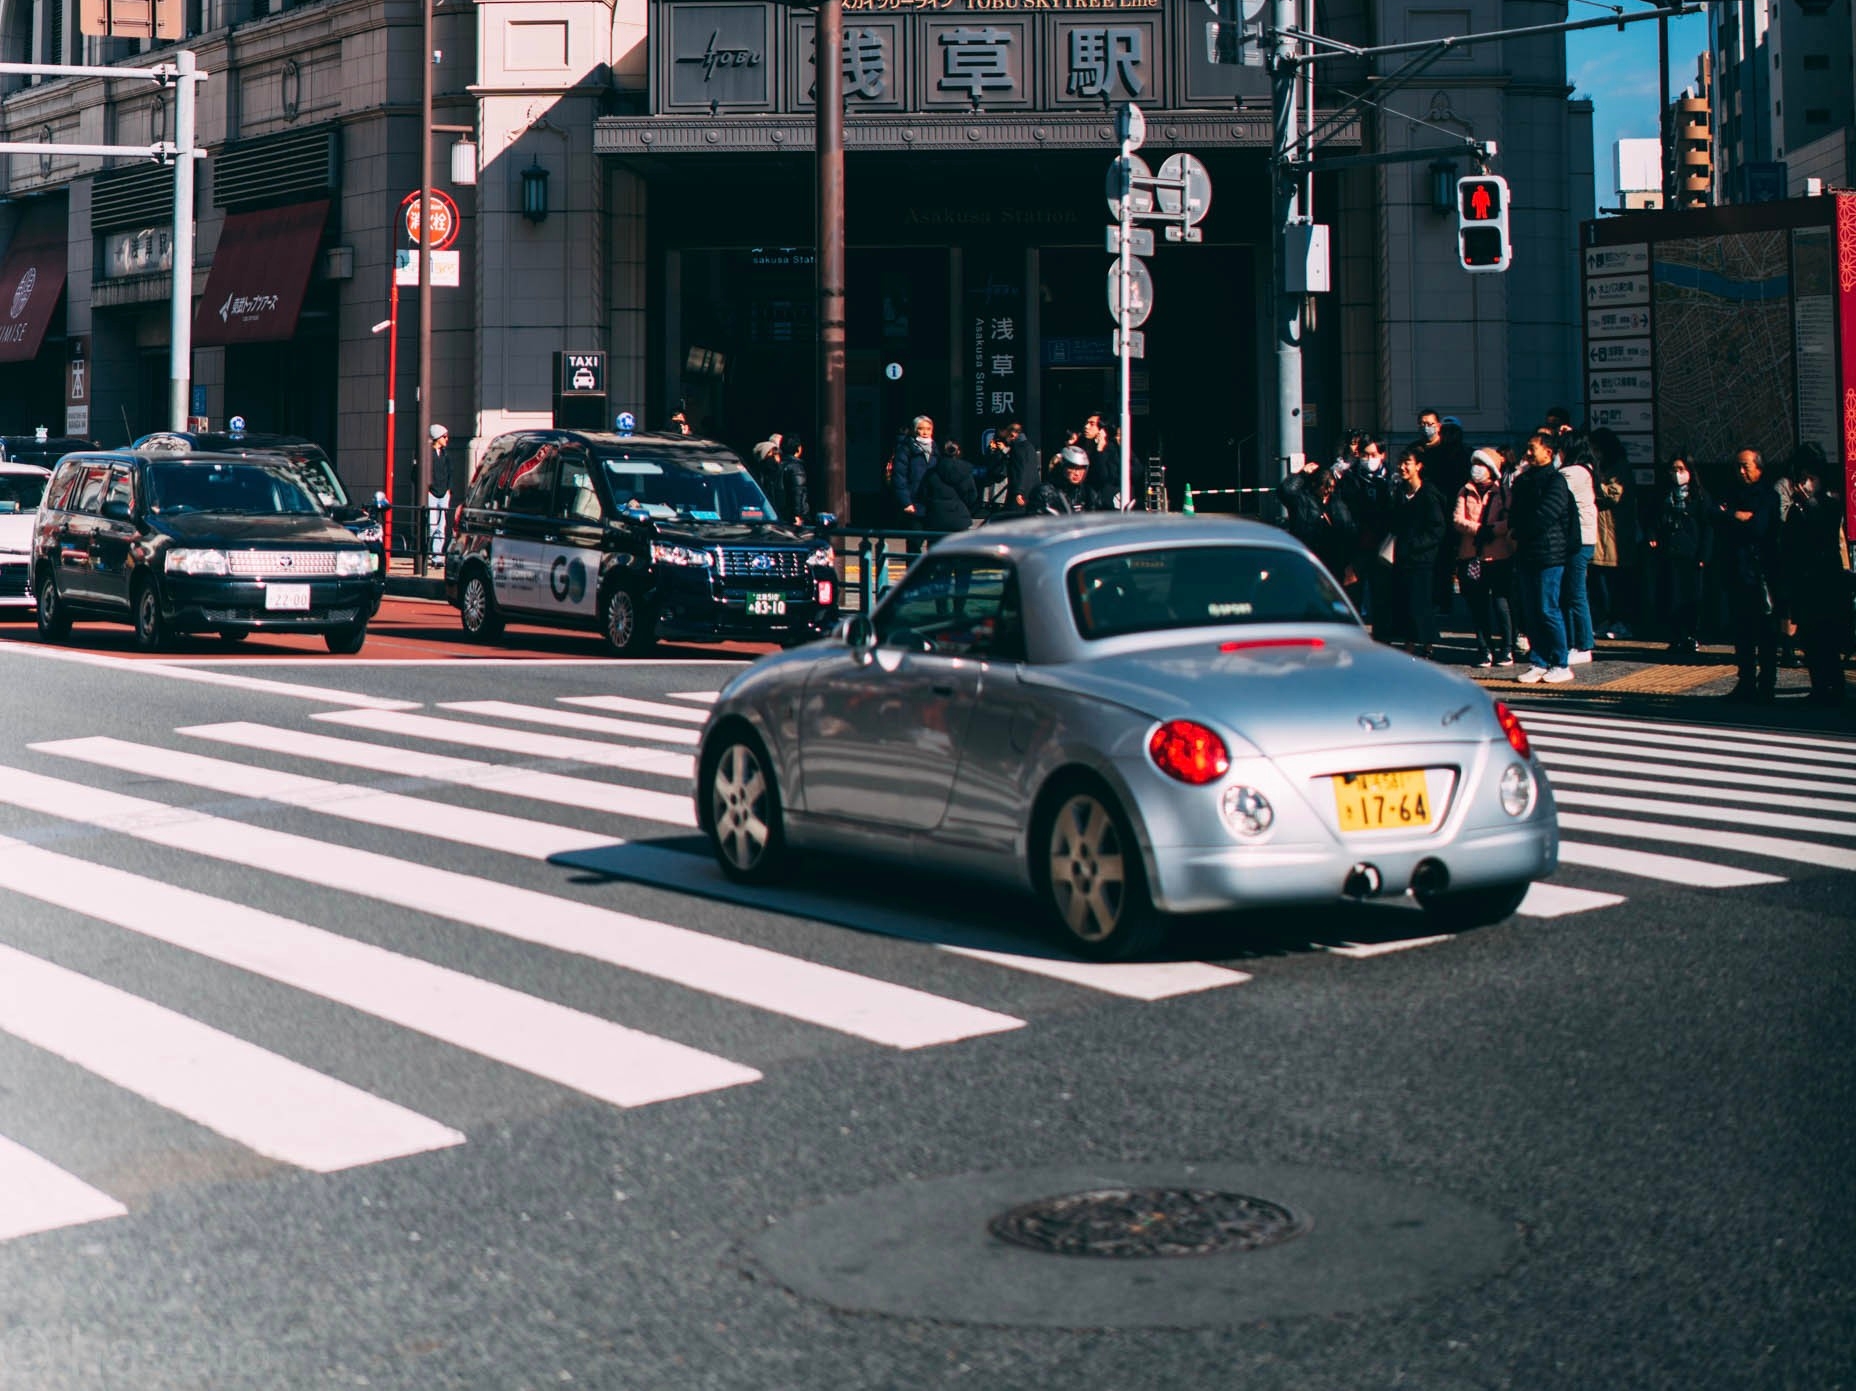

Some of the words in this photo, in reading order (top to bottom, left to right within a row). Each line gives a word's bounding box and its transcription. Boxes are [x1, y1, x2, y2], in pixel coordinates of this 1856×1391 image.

[569, 356, 598, 367] TAXI
[975, 317, 985, 368] Asakusa
[991, 316, 1015, 415] 浅草駅
[975, 372, 985, 415] Station
[1361, 792, 1427, 825] 17-64
